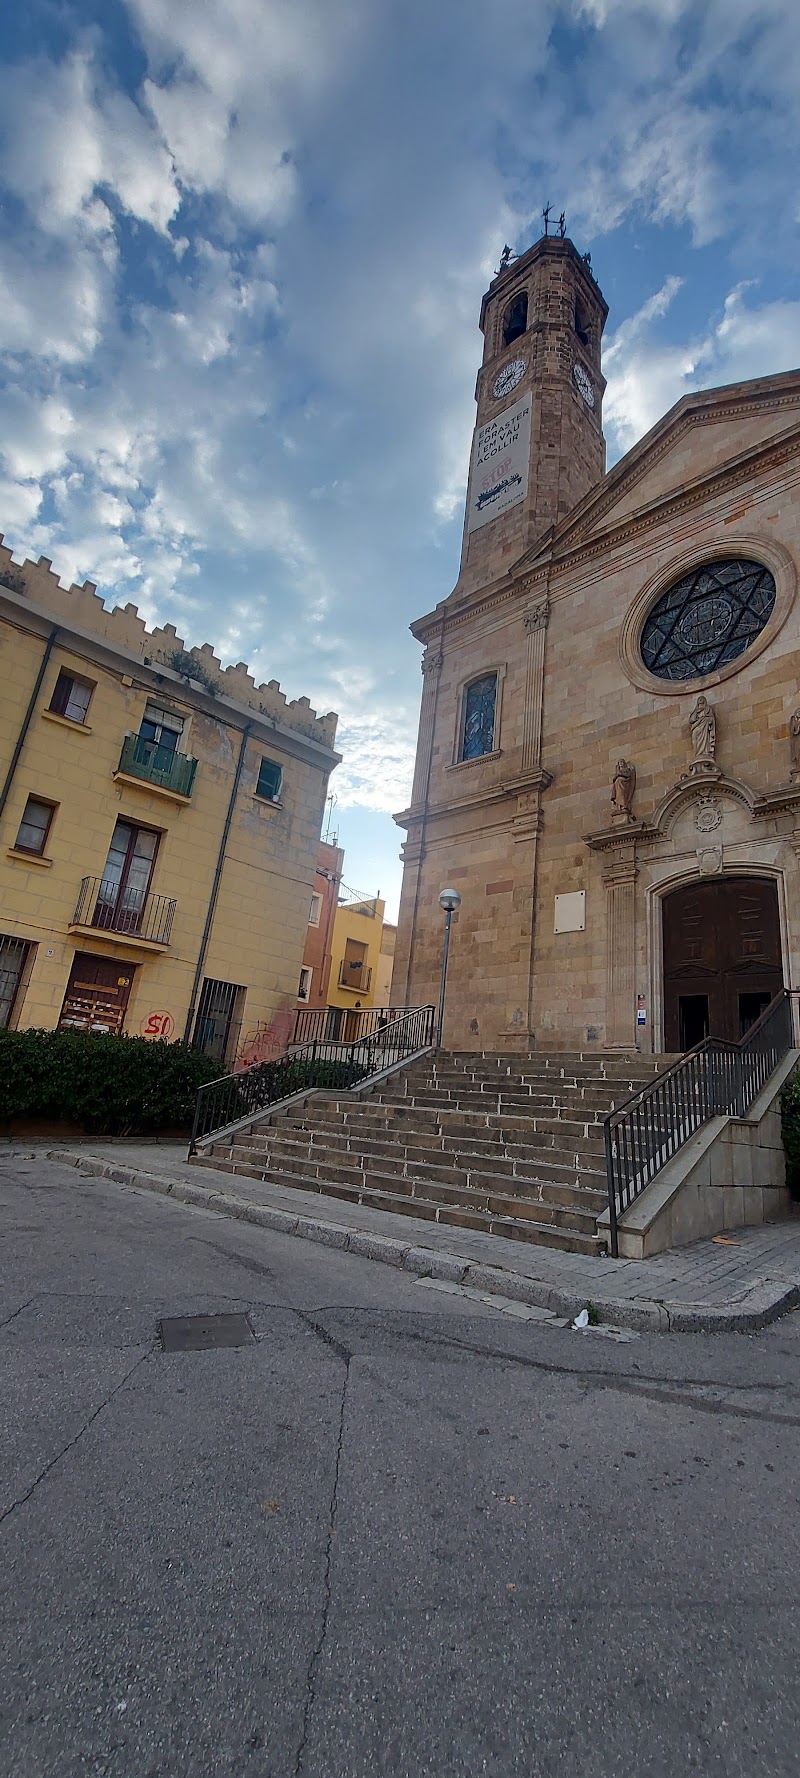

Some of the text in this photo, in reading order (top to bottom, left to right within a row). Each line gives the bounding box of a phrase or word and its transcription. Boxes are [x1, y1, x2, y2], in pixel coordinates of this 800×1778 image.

[478, 407, 530, 448] FORASTER
[479, 422, 498, 439] ERA
[484, 440, 497, 453] EM
[500, 423, 520, 441] VAU
[477, 433, 519, 466] ACOLLIR
[481, 458, 513, 489] STOP
